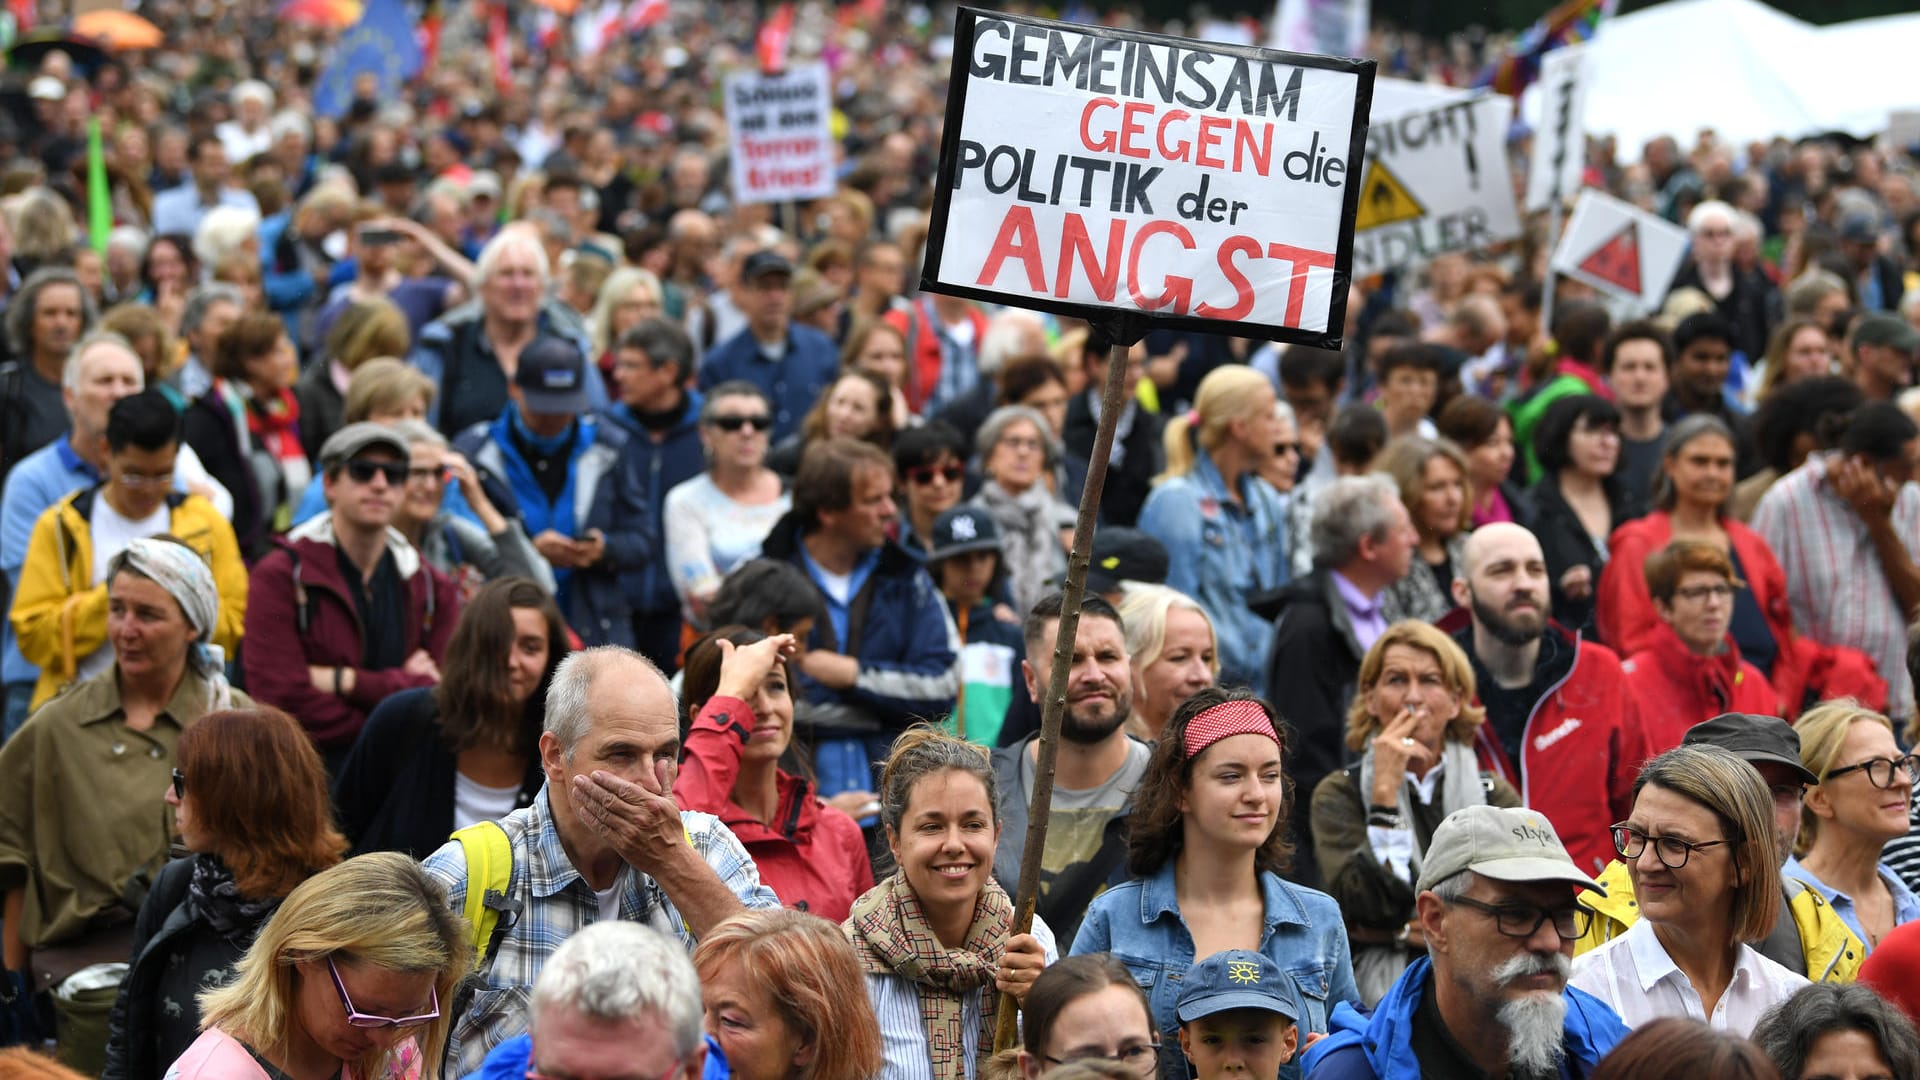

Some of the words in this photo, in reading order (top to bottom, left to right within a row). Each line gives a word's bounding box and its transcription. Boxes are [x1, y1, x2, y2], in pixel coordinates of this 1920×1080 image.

[968, 17, 1304, 122] GEMEINSAM
[952, 139, 1164, 215] POLITIK
[1176, 173, 1249, 226] der
[1079, 96, 1275, 177] GEGEN
[1282, 130, 1346, 188] die
[975, 204, 1336, 329] ANGST
